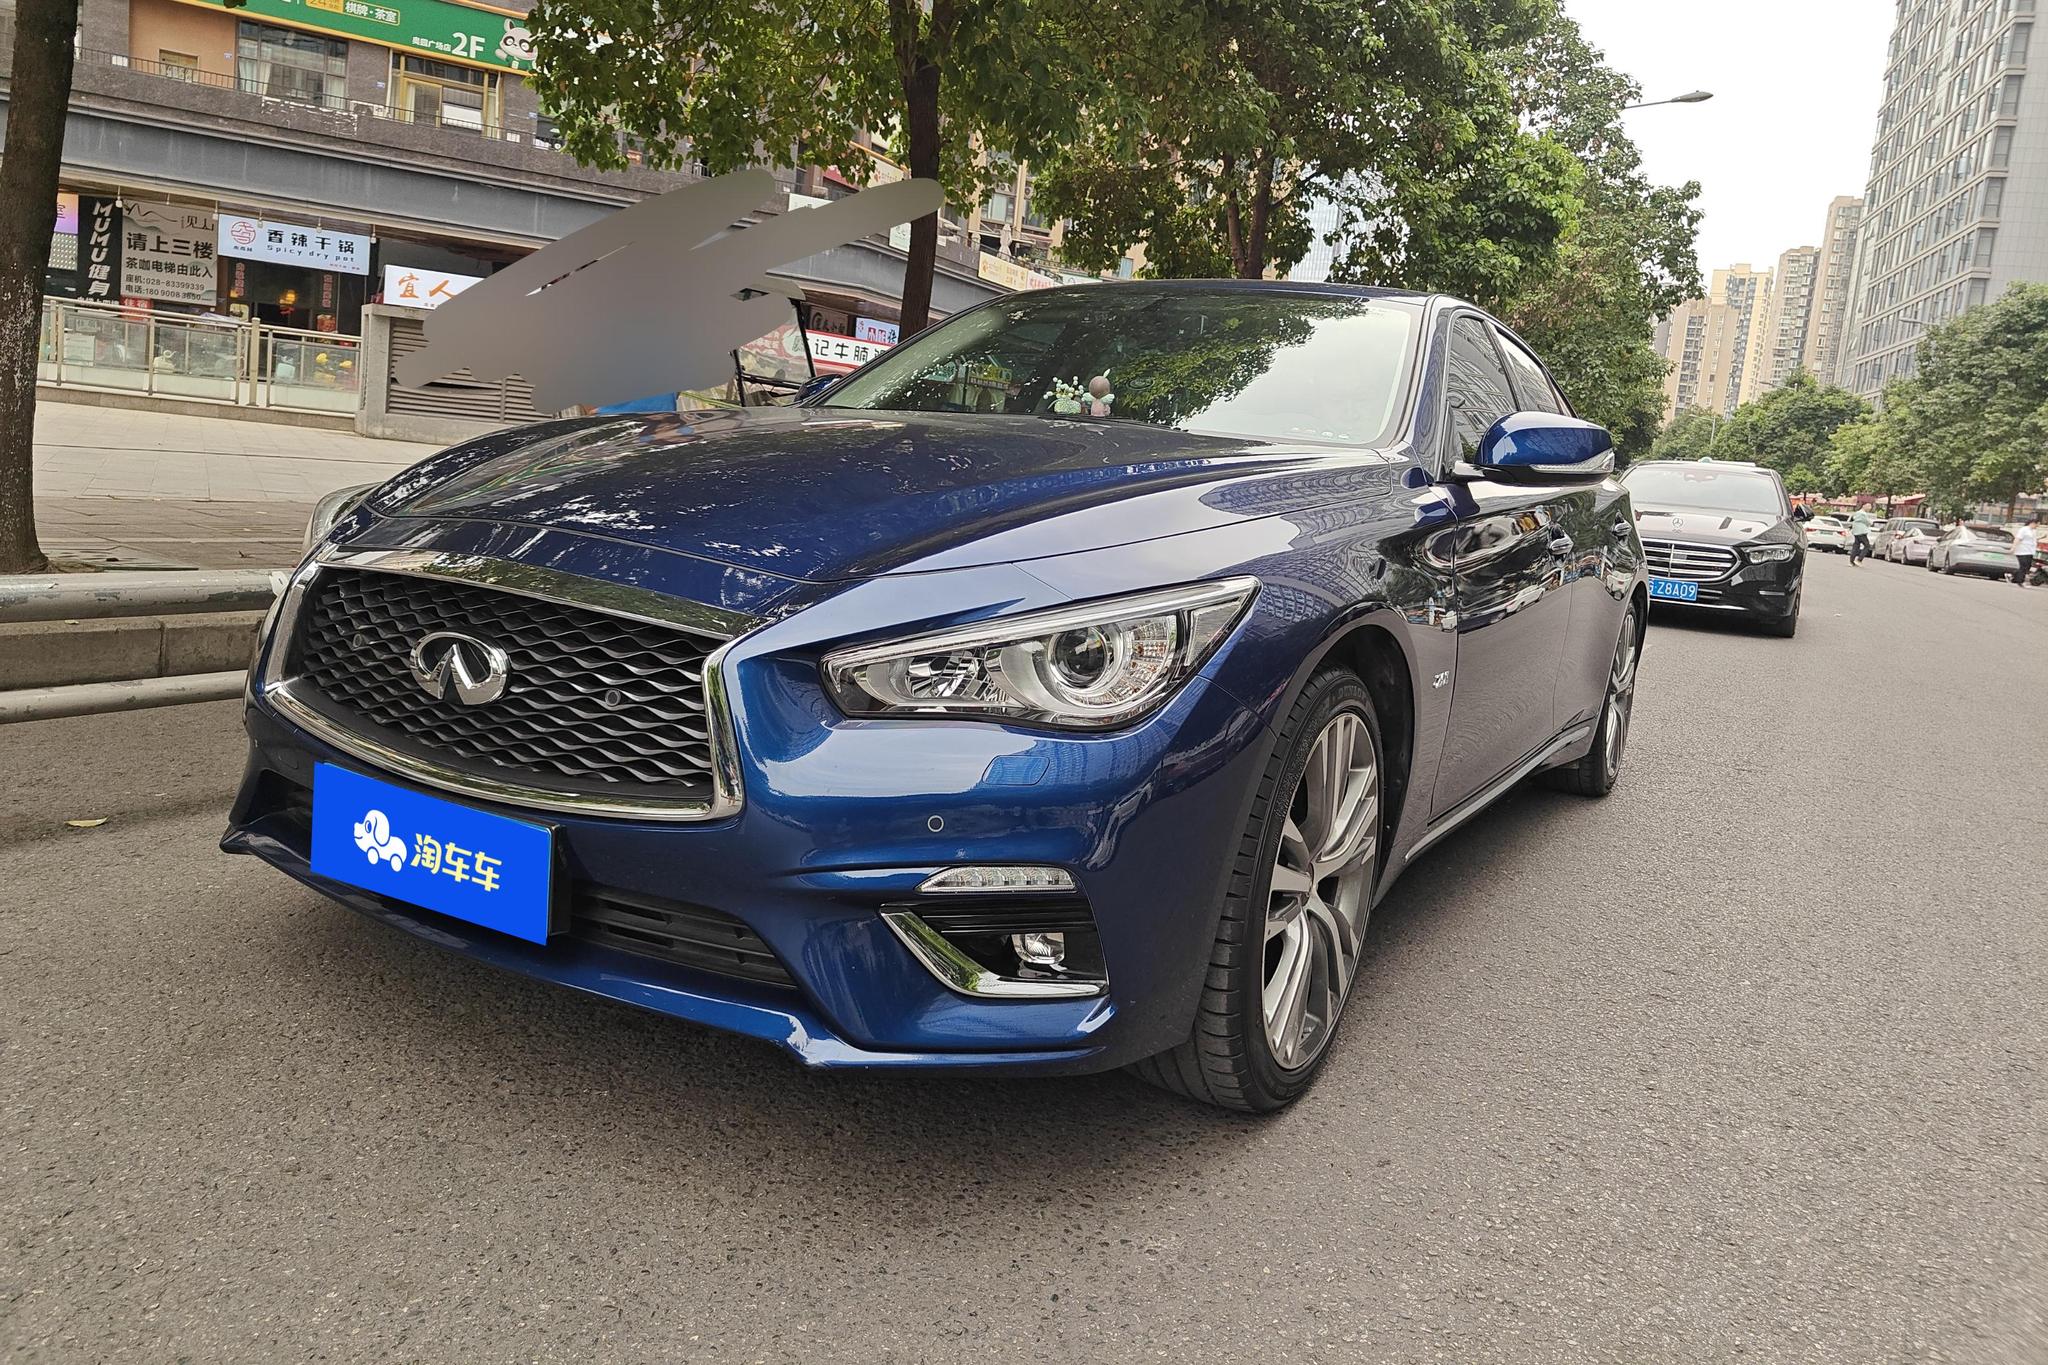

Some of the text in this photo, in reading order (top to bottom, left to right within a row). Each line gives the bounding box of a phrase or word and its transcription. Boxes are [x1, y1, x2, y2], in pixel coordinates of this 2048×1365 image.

[451, 32, 486, 59] 2F
[126, 232, 214, 260] 请上三楼
[267, 229, 355, 255] 香辣干锅
[267, 244, 355, 263] Spicy dry pot
[125, 257, 214, 279] 茶咖电梯由此入
